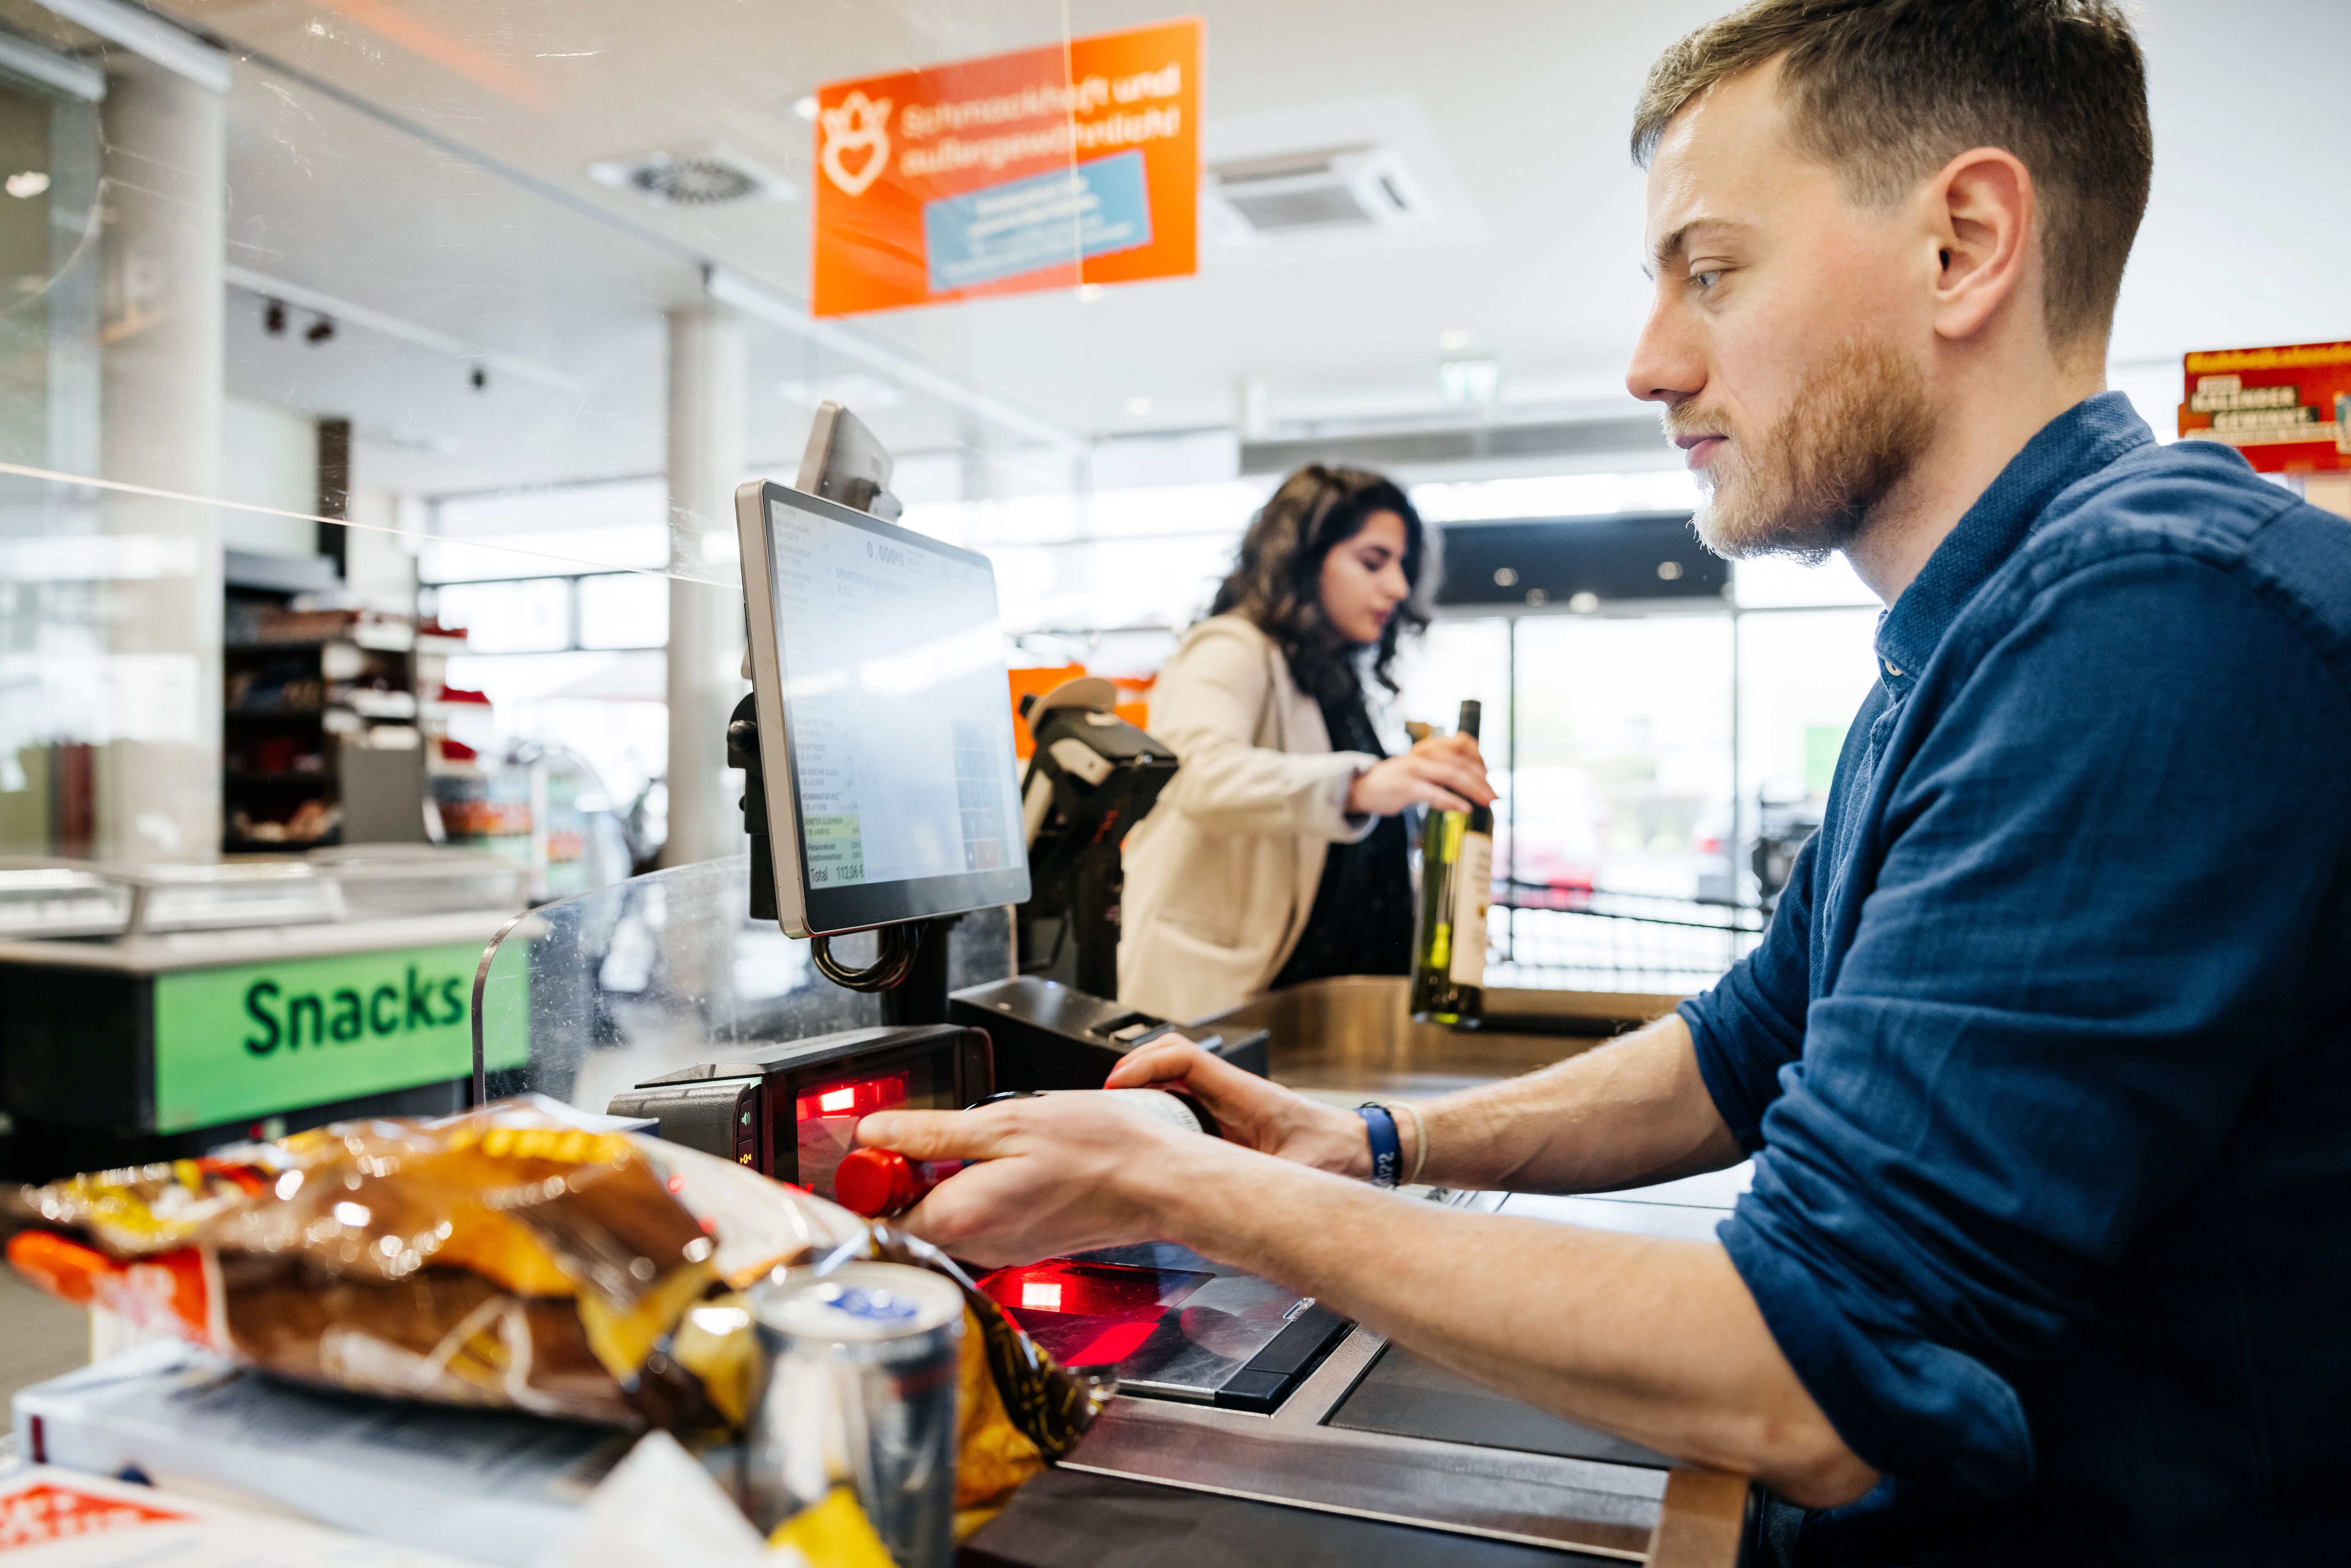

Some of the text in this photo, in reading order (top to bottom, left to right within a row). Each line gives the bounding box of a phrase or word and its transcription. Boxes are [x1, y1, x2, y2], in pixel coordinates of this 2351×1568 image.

[901, 62, 1181, 139] Schmackhaft und
[810, 866, 829, 883] Total
[836, 864, 859, 882] 112,06
[243, 964, 464, 1058] Snacks
